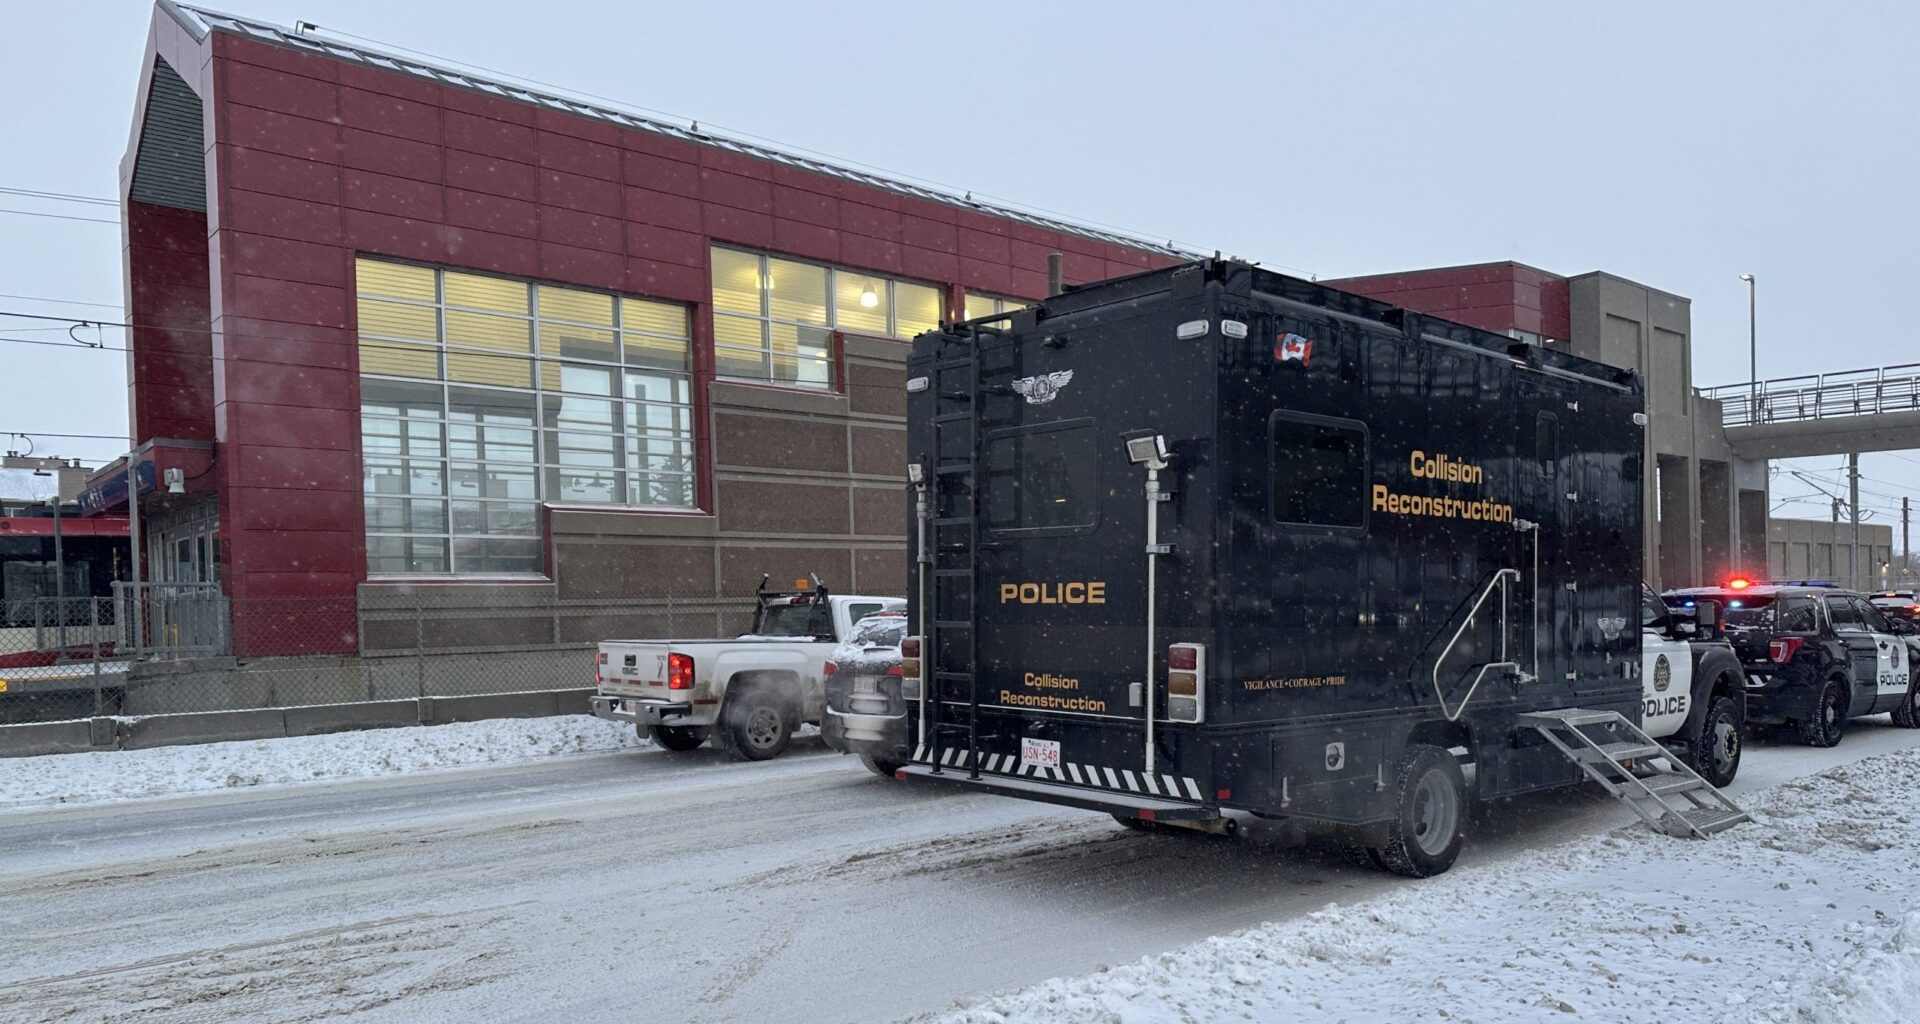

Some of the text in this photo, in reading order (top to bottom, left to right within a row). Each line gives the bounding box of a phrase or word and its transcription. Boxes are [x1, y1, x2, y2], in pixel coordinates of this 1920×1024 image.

[1411, 450, 1482, 484] Collision
[1373, 484, 1512, 522] Reconstruction
[1000, 582, 1106, 604] POLICE
[1024, 672, 1079, 690] Collision
[1244, 676, 1345, 690] VIGILANCE COURAGE PRIDE
[1880, 673, 1907, 686] POLICE
[1000, 690, 1106, 711] Reconstruction
[1023, 747, 1058, 762] USN-548
